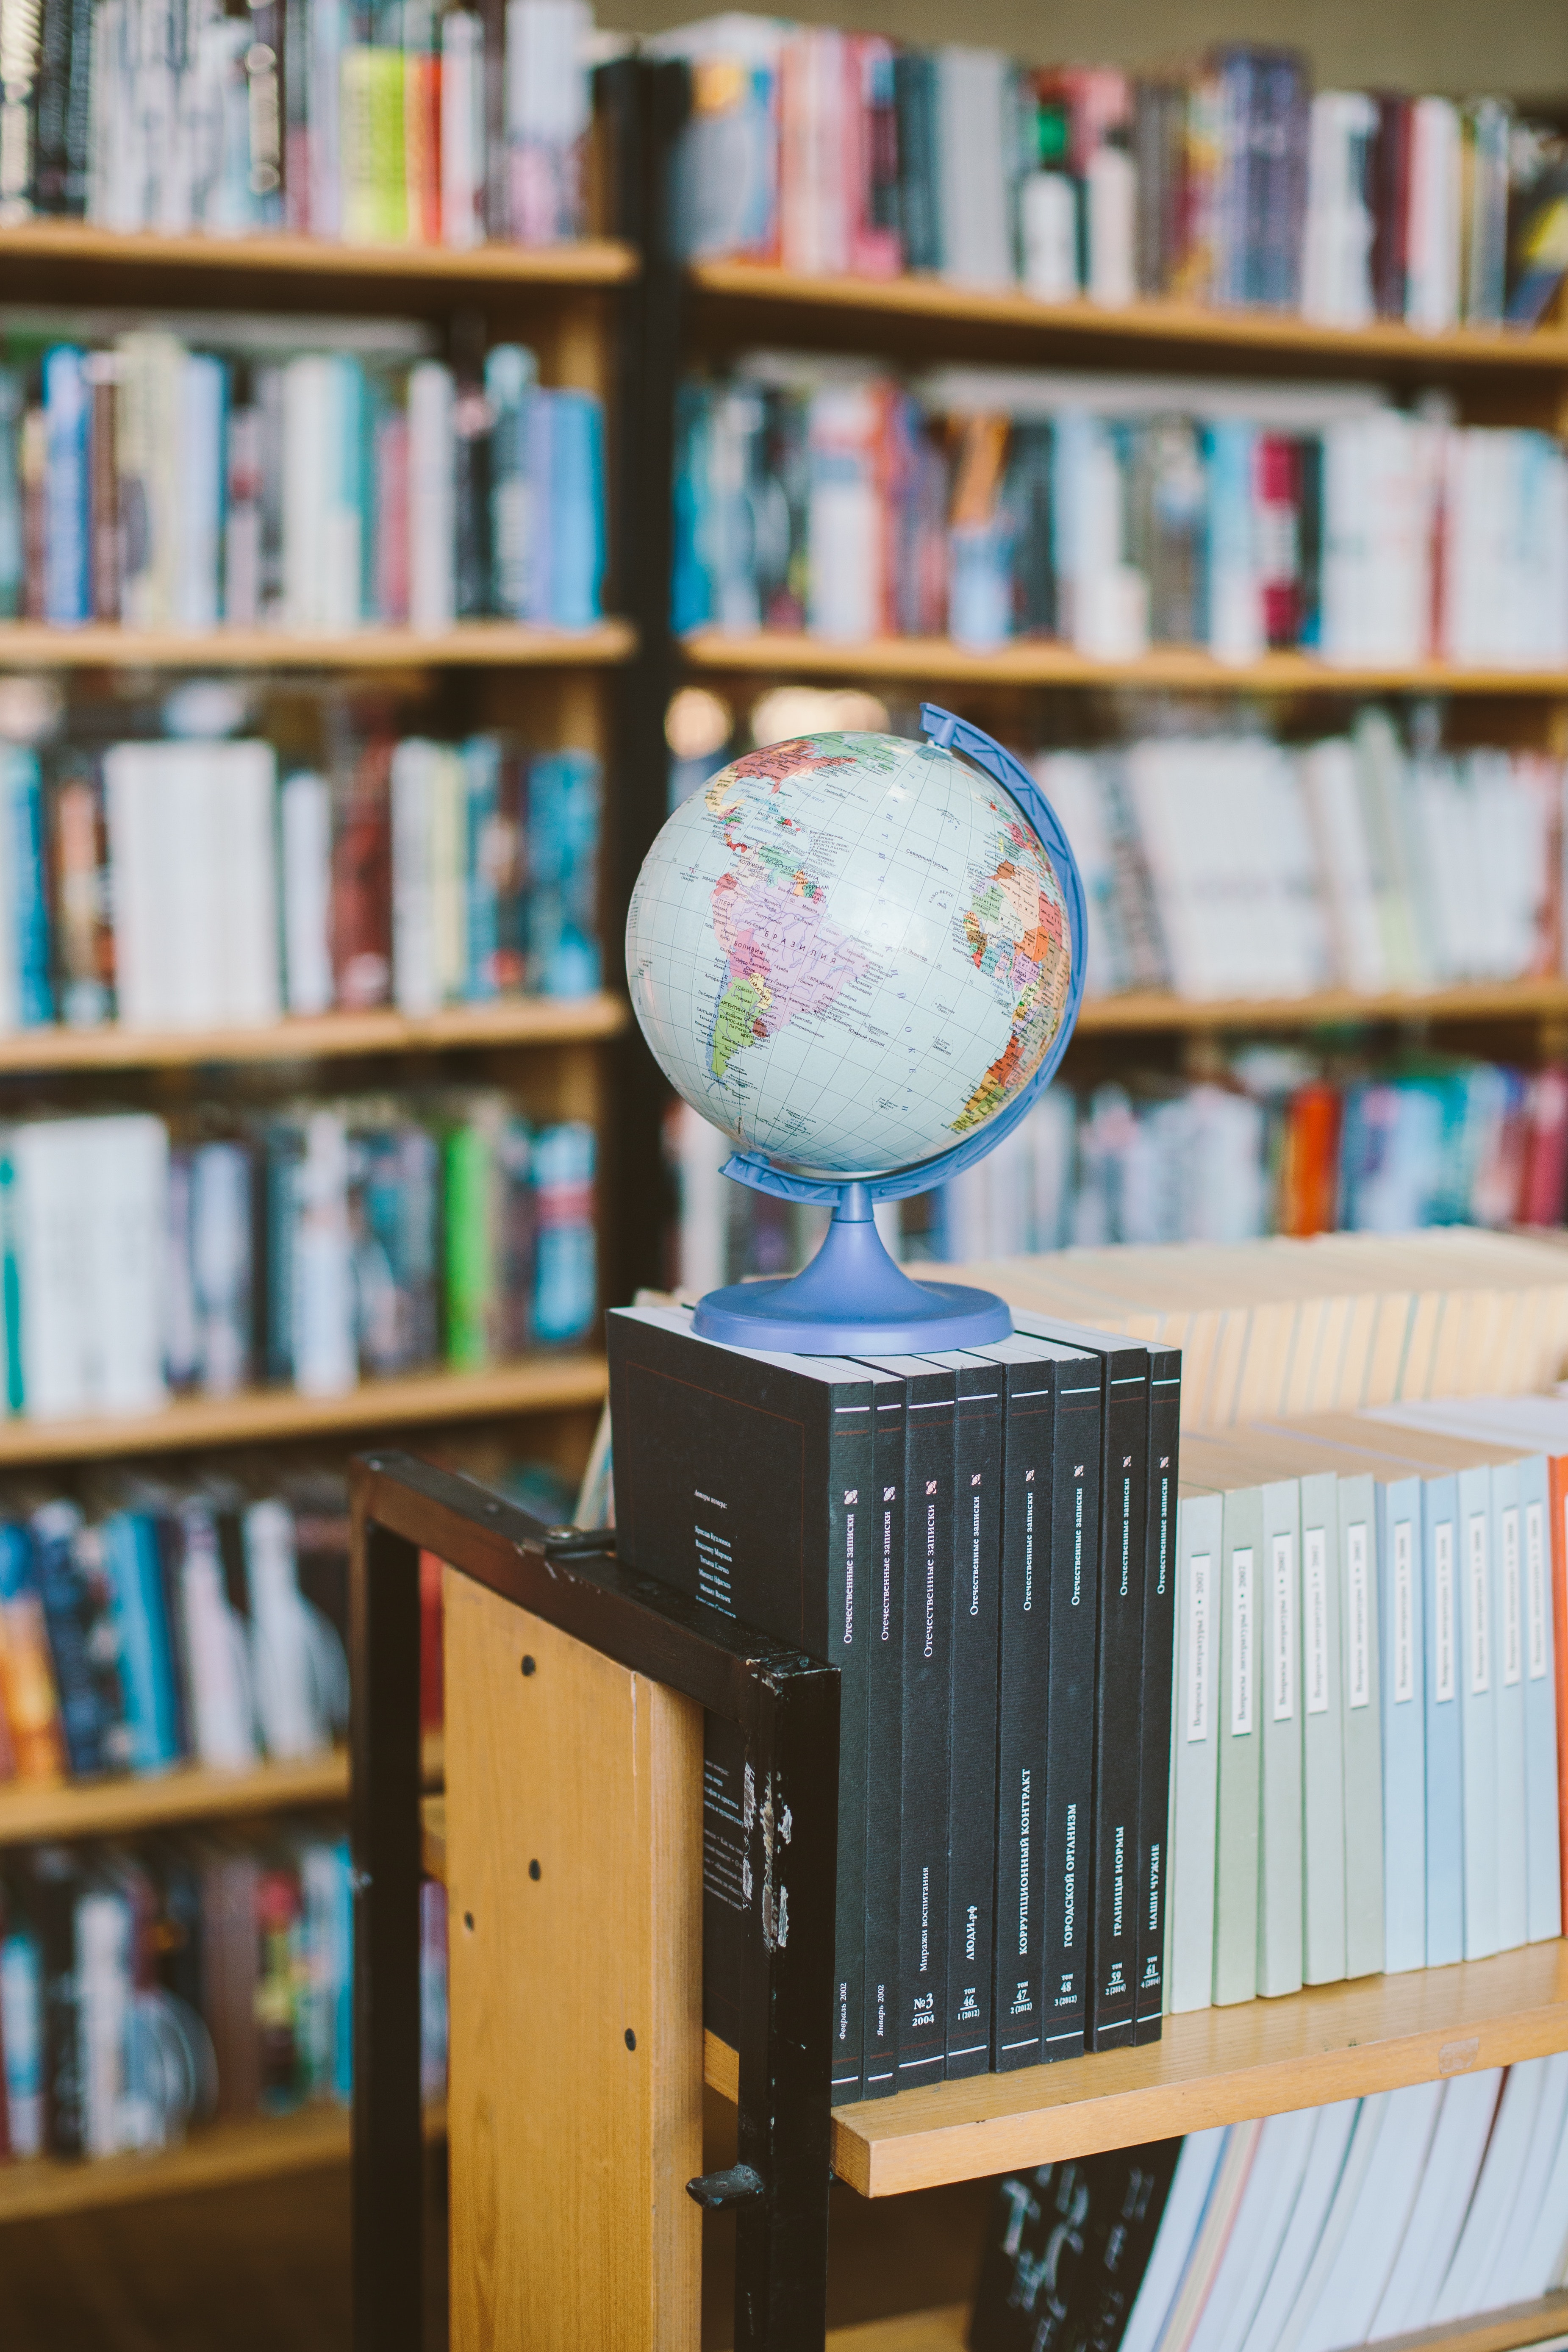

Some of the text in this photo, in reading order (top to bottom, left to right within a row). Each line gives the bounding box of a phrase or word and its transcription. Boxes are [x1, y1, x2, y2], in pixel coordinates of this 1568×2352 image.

[772, 845, 791, 855] КАРАКАС
[738, 858, 765, 871] КОЛУМБИЯ
[765, 858, 795, 874] ВЕНЕСУЭЛА
[906, 849, 949, 872] Северный тропик
[718, 899, 734, 908] ПЕРУ
[928, 889, 954, 904] КАБО-ВЕРДЕ
[755, 911, 783, 925] Порту-Велью
[764, 930, 836, 964] БРАЗИЛИЯ
[968, 934, 986, 946] ГВИНЕЯ
[734, 941, 763, 955] БОЛИВИЯ
[735, 957, 748, 965] Оруро
[908, 949, 927, 962] Экватор
[749, 961, 772, 972] Санта-Крус
[776, 964, 788, 973] Куяба
[810, 976, 834, 990] БРАЗИЛИА
[848, 982, 872, 996] Сальвадор
[854, 978, 873, 990] Аракажу
[839, 991, 857, 1002] Итабуна
[721, 1000, 746, 1014] АРГЕНТИНА
[792, 1014, 813, 1025] Куритиба
[790, 1021, 825, 1039] Флорианополис
[848, 1027, 885, 1047] Южный тропик
[740, 1033, 771, 1044] МОНТЕВИДЕО
[1120, 1520, 1129, 1596] Отечественные
[1157, 1519, 1167, 1594] Отечественные
[1023, 1534, 1032, 1611] Отечественные
[1071, 1530, 1082, 1606] Отечественные
[970, 1538, 979, 1615] Отечественные
[844, 1560, 854, 1644] Отечественные
[881, 1557, 890, 1641] Отечественные
[924, 1559, 934, 1658] Отечественные
[1019, 1769, 1030, 1955] КОРРУПЦИОННЫЙ КОНТРАКТ
[1064, 1804, 1076, 1948] ГОРОДСКОЙ ОРГАНИЗМ
[1113, 1826, 1124, 1937] ГРАНИЦЫ НОРМЫ
[1149, 1844, 1160, 1930] НАШИ ЧУЖИЕ
[966, 1905, 977, 1960] ЛЮДИ.рф
[920, 1929, 929, 1972] Миражи
[1146, 1963, 1156, 1975] 61
[1111, 1970, 1121, 1983] 59
[1061, 1981, 1072, 1993] 48
[963, 1994, 974, 2007] 46
[1016, 1989, 1027, 2001] 47
[1054, 1994, 1078, 2006] 3 (2012)
[962, 2008, 980, 2021] (2012)
[1015, 2002, 1032, 2014] (2012)
[839, 2005, 848, 2040] Февраль
[877, 2005, 885, 2037] Январь
[912, 2013, 935, 2027] 2004
